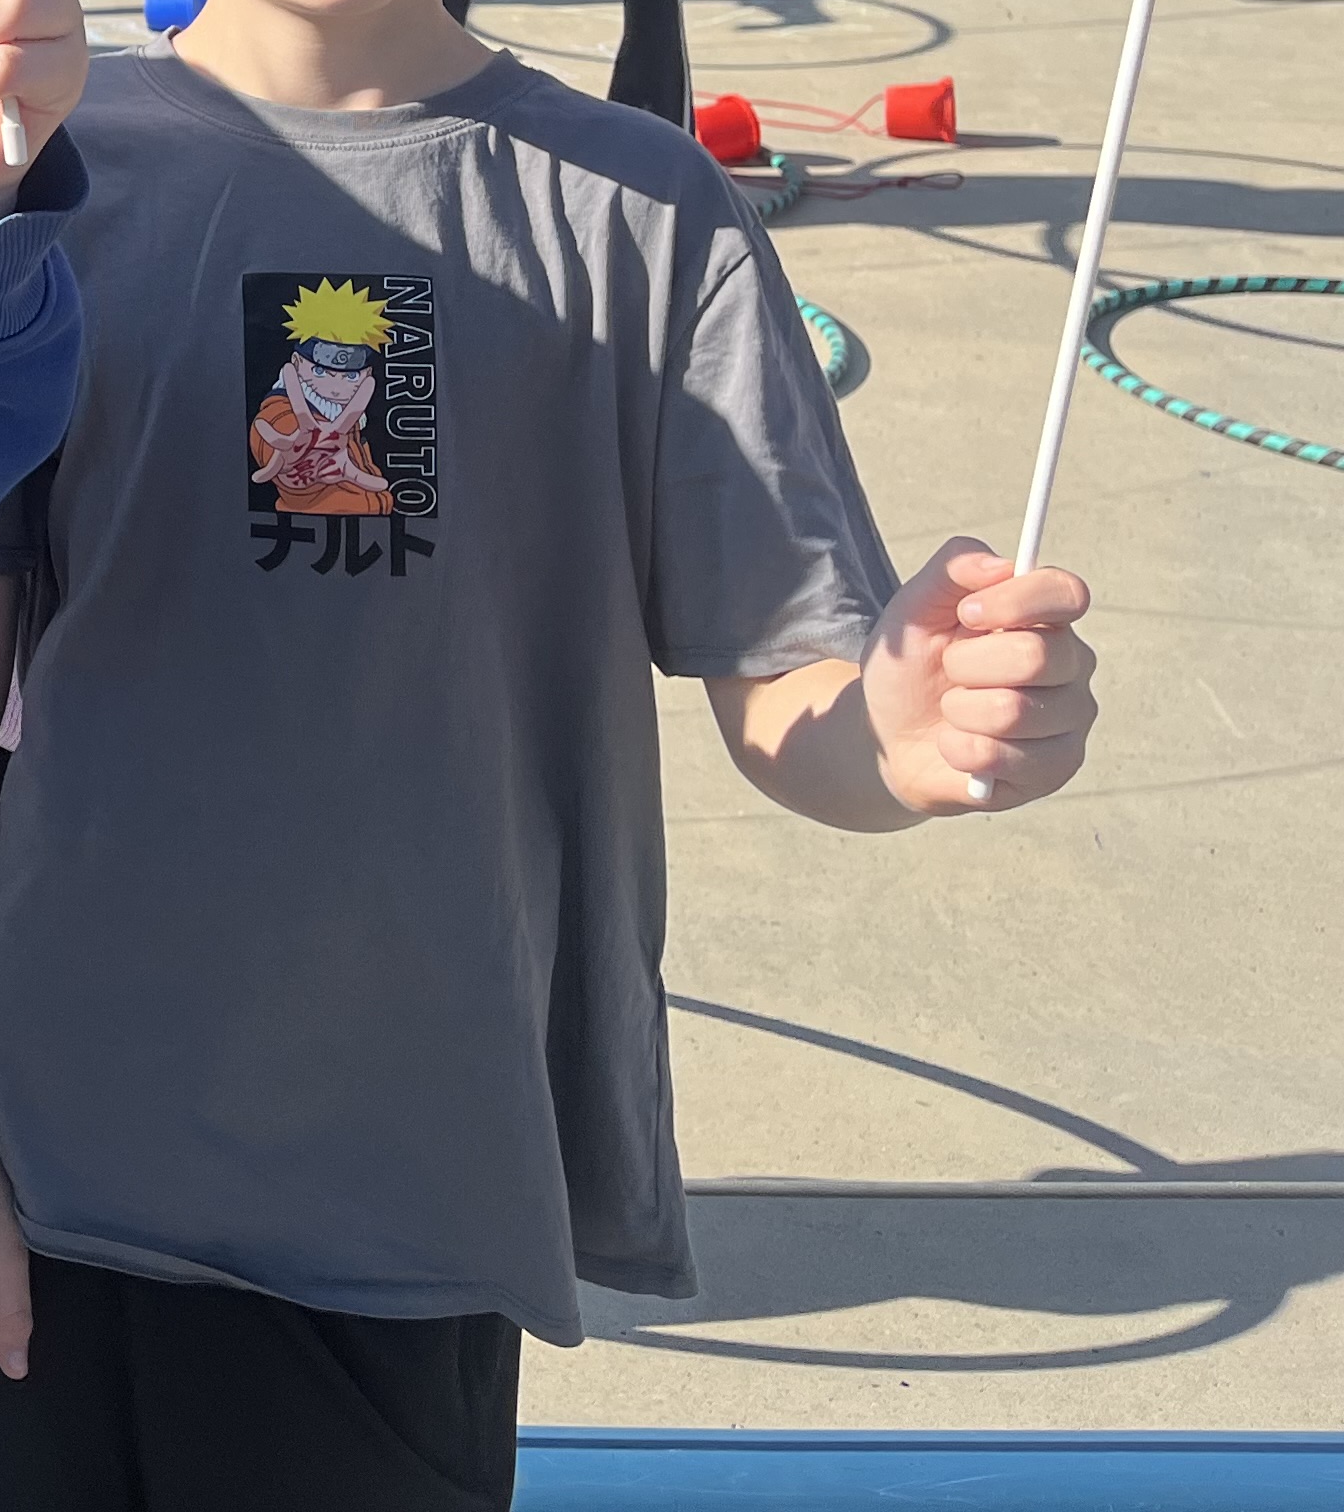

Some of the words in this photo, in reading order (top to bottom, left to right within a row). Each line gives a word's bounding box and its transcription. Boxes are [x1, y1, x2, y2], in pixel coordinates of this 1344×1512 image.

[384, 276, 436, 517] NARUTO
[250, 512, 436, 578] ナルト
